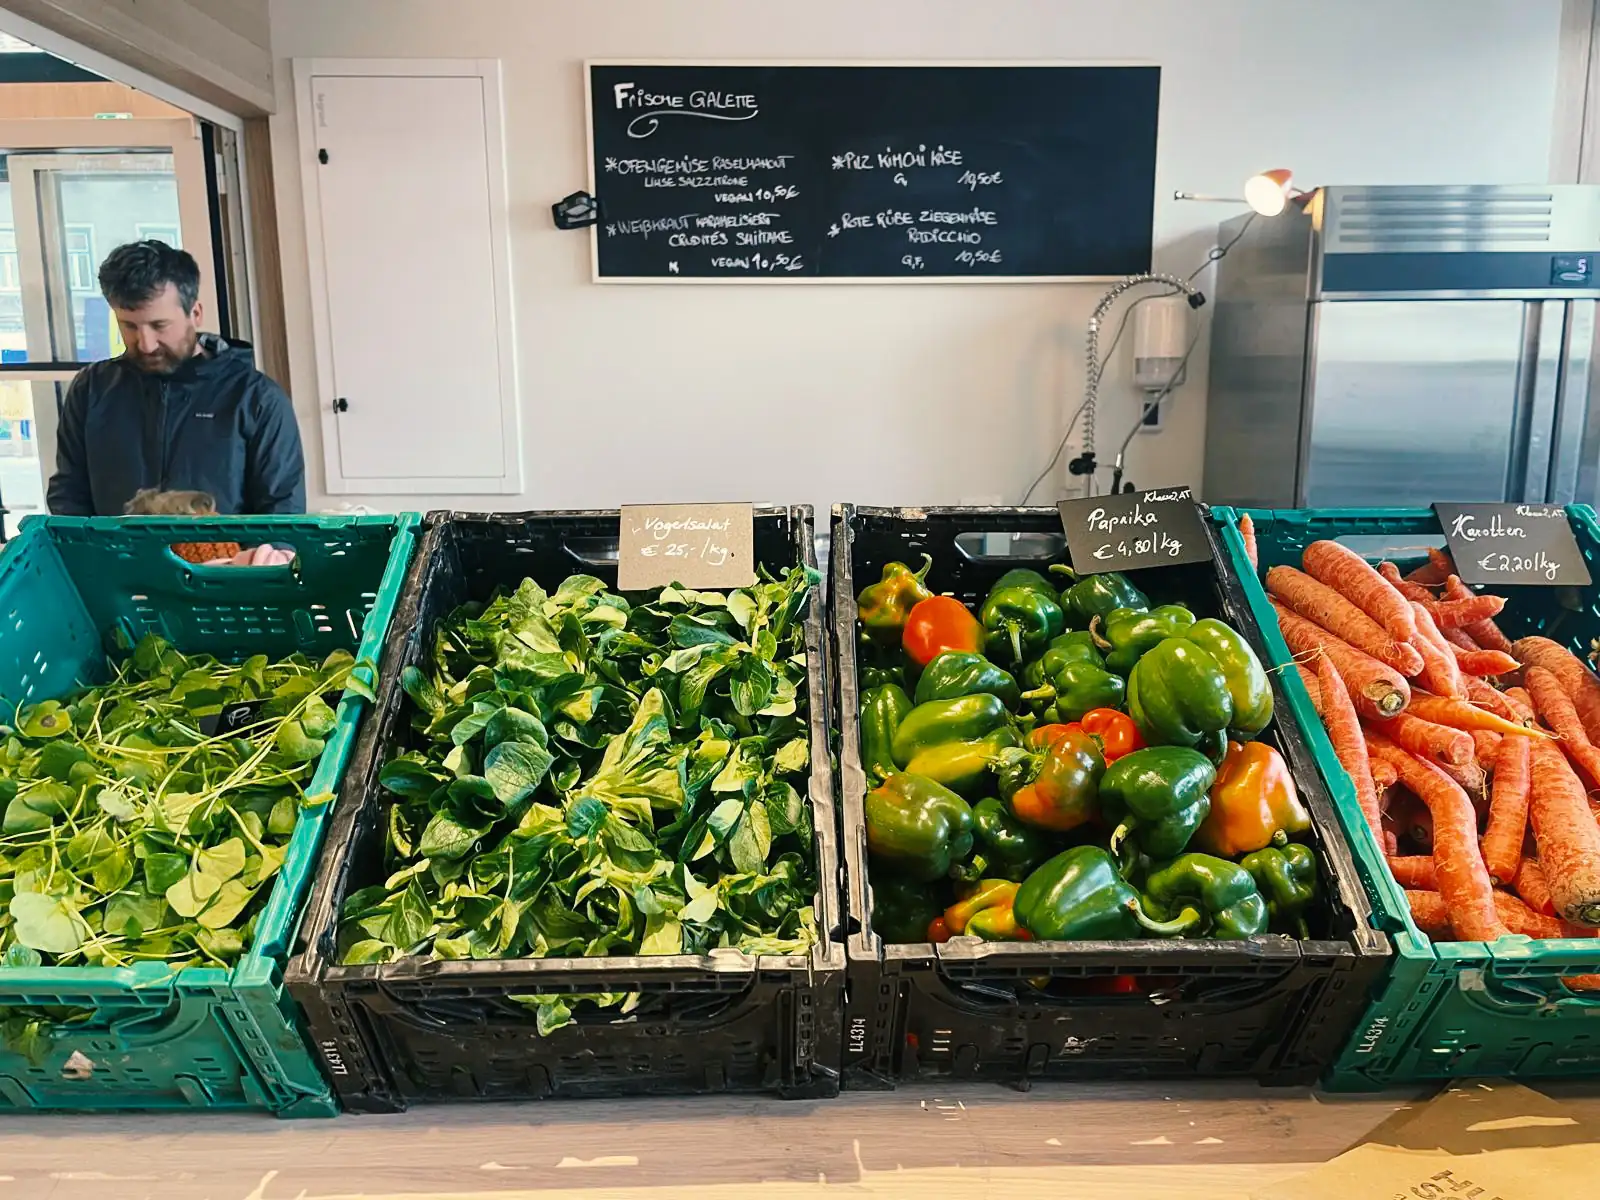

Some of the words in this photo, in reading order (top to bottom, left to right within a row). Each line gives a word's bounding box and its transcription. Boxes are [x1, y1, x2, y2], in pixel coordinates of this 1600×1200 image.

[715, 193, 753, 203] VEGAN
[712, 257, 749, 268] VEGAN
[1087, 503, 1158, 533] Paprika
[849, 1018, 866, 1052] LL4314
[1356, 1016, 1389, 1052] LL4314
